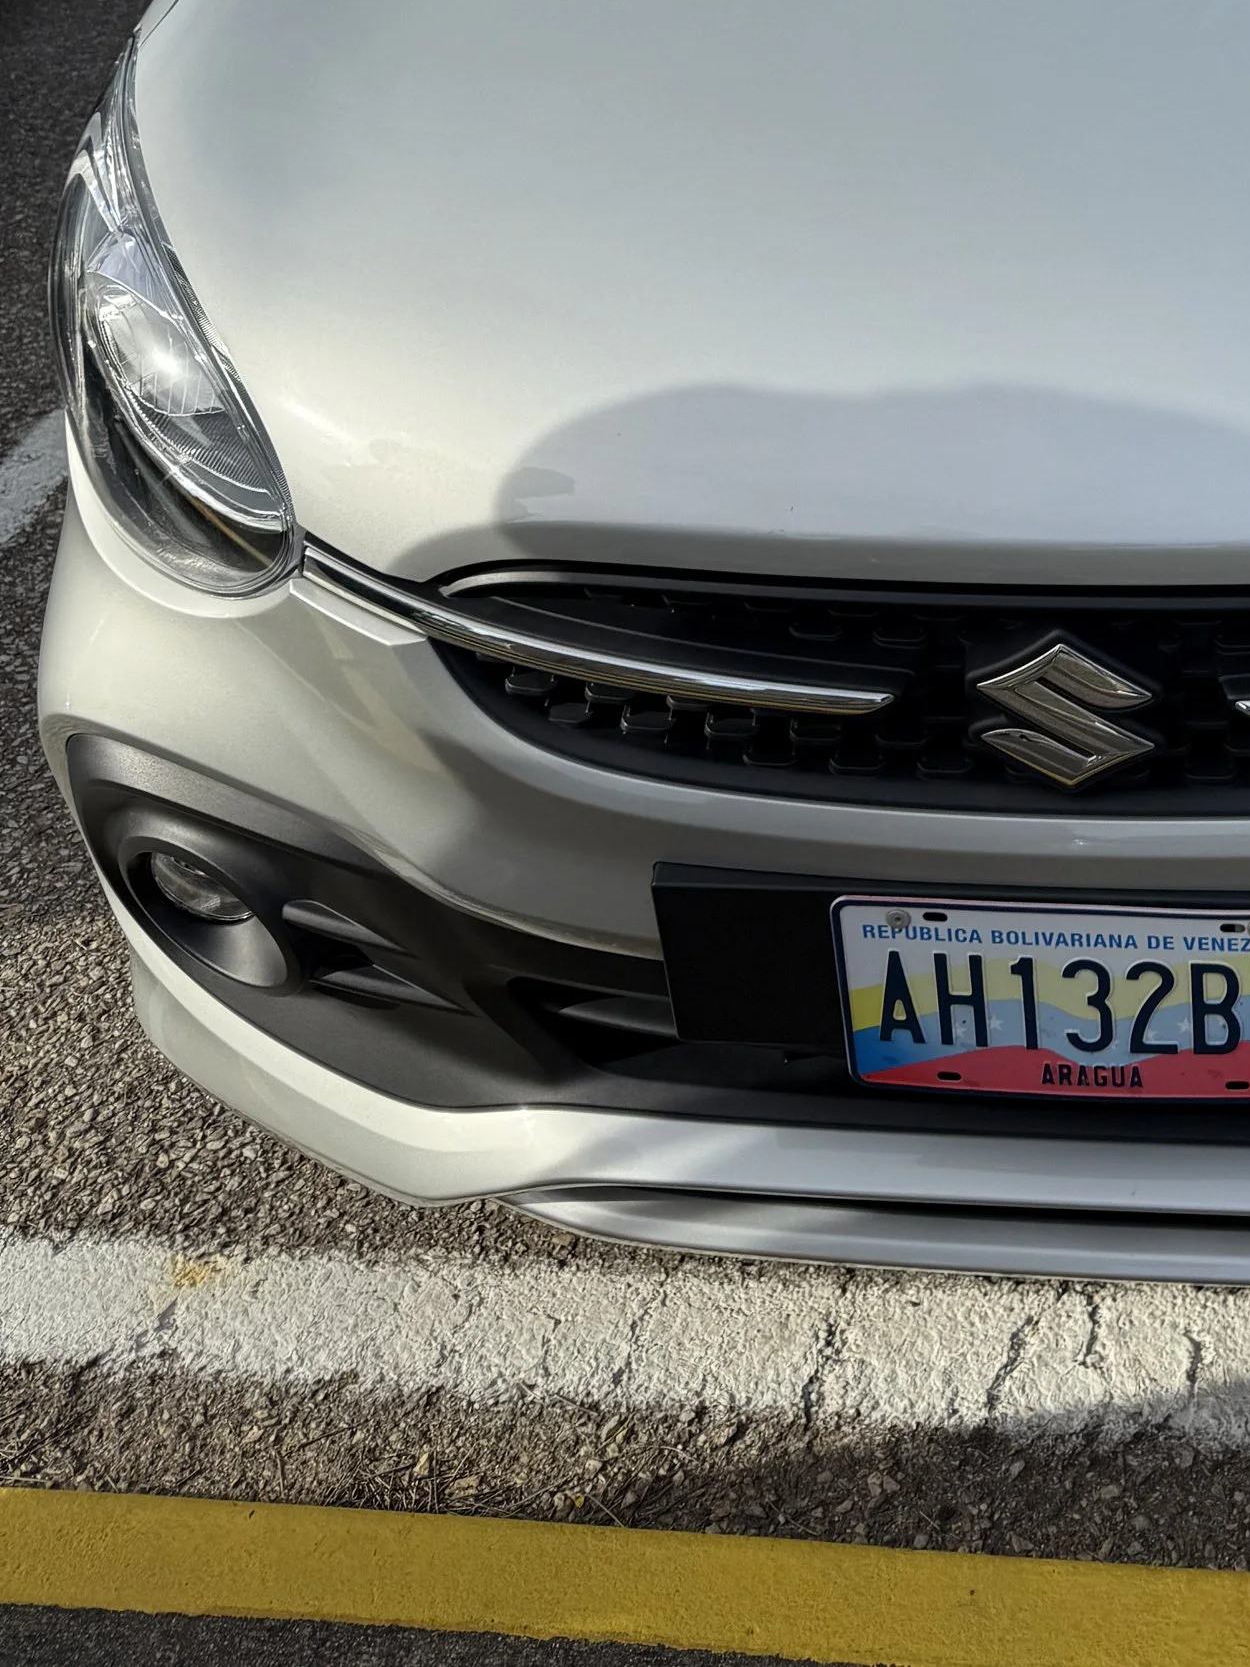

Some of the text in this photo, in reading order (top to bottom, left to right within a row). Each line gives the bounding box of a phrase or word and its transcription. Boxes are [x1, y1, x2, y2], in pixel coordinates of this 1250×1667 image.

[862, 923, 982, 945] REPUBLICA
[991, 929, 1138, 951] BOLIVARIANA
[1146, 936, 1176, 952] DE
[1042, 1062, 1144, 1089] ARAGUA
